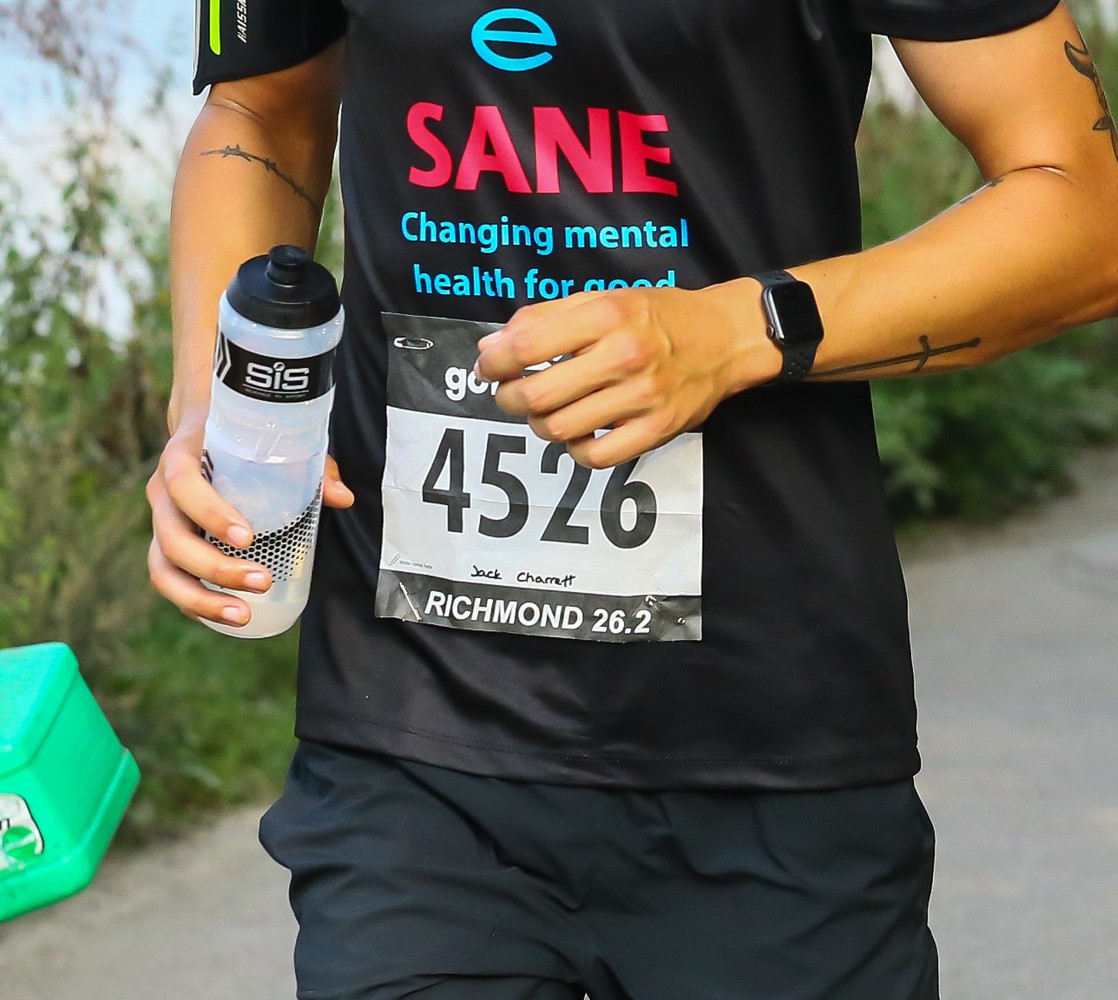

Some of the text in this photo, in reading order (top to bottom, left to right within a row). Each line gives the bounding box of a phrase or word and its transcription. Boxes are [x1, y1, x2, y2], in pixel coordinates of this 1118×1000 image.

[405, 101, 679, 197] SANE
[401, 211, 690, 256] Changing mental
[413, 263, 516, 299] health
[524, 269, 575, 299] for
[421, 427, 658, 550] 4526
[470, 565, 503, 580] Jack
[424, 590, 652, 635] RICHMOND 26.2
